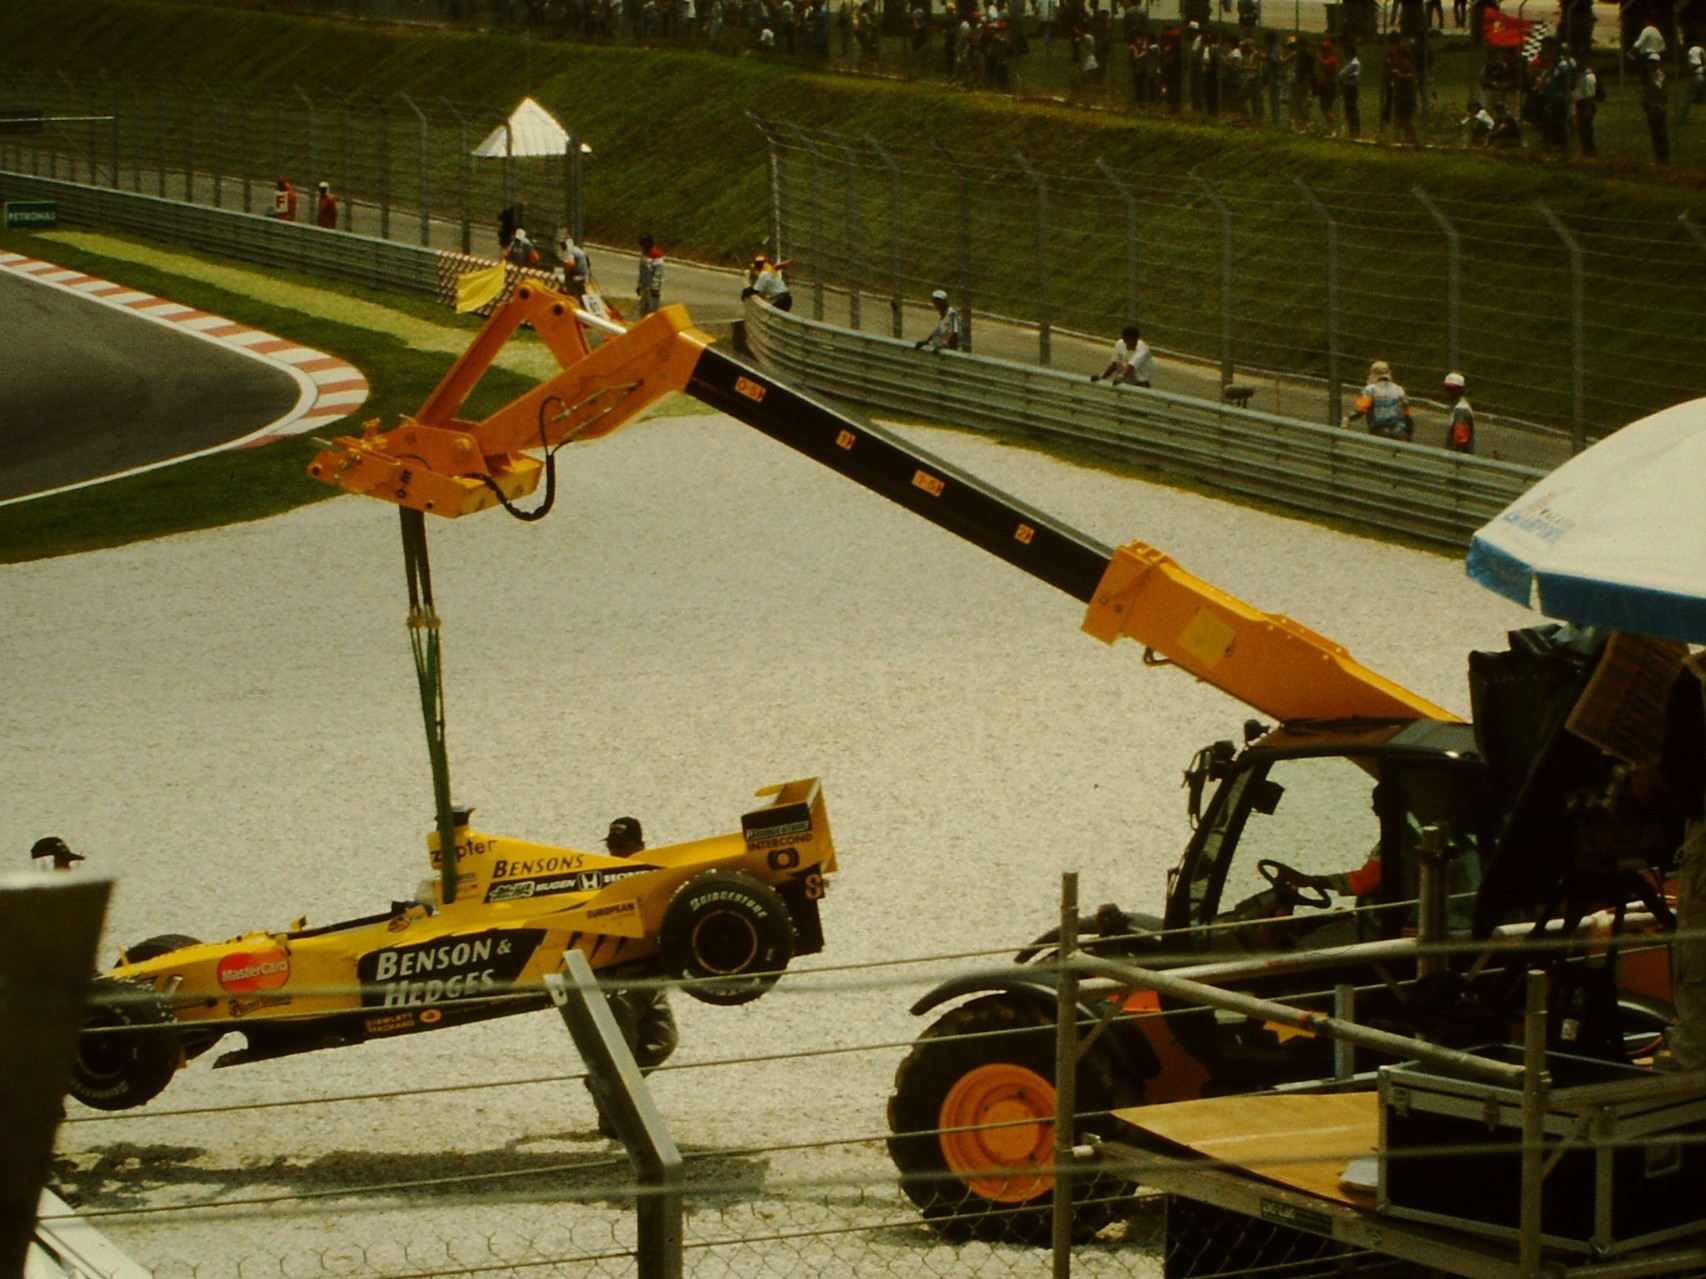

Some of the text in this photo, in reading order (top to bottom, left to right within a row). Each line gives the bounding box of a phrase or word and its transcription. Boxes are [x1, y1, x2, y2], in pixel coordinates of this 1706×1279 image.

[276, 195, 285, 209] F
[8, 211, 57, 221] PETRONAS
[430, 838, 498, 862] zpter
[492, 854, 584, 879] BENSONS
[587, 902, 635, 919] EUROPEAN
[222, 960, 288, 982] MasterCard
[376, 938, 512, 981] BENSON &
[383, 968, 495, 1008] HEDGES
